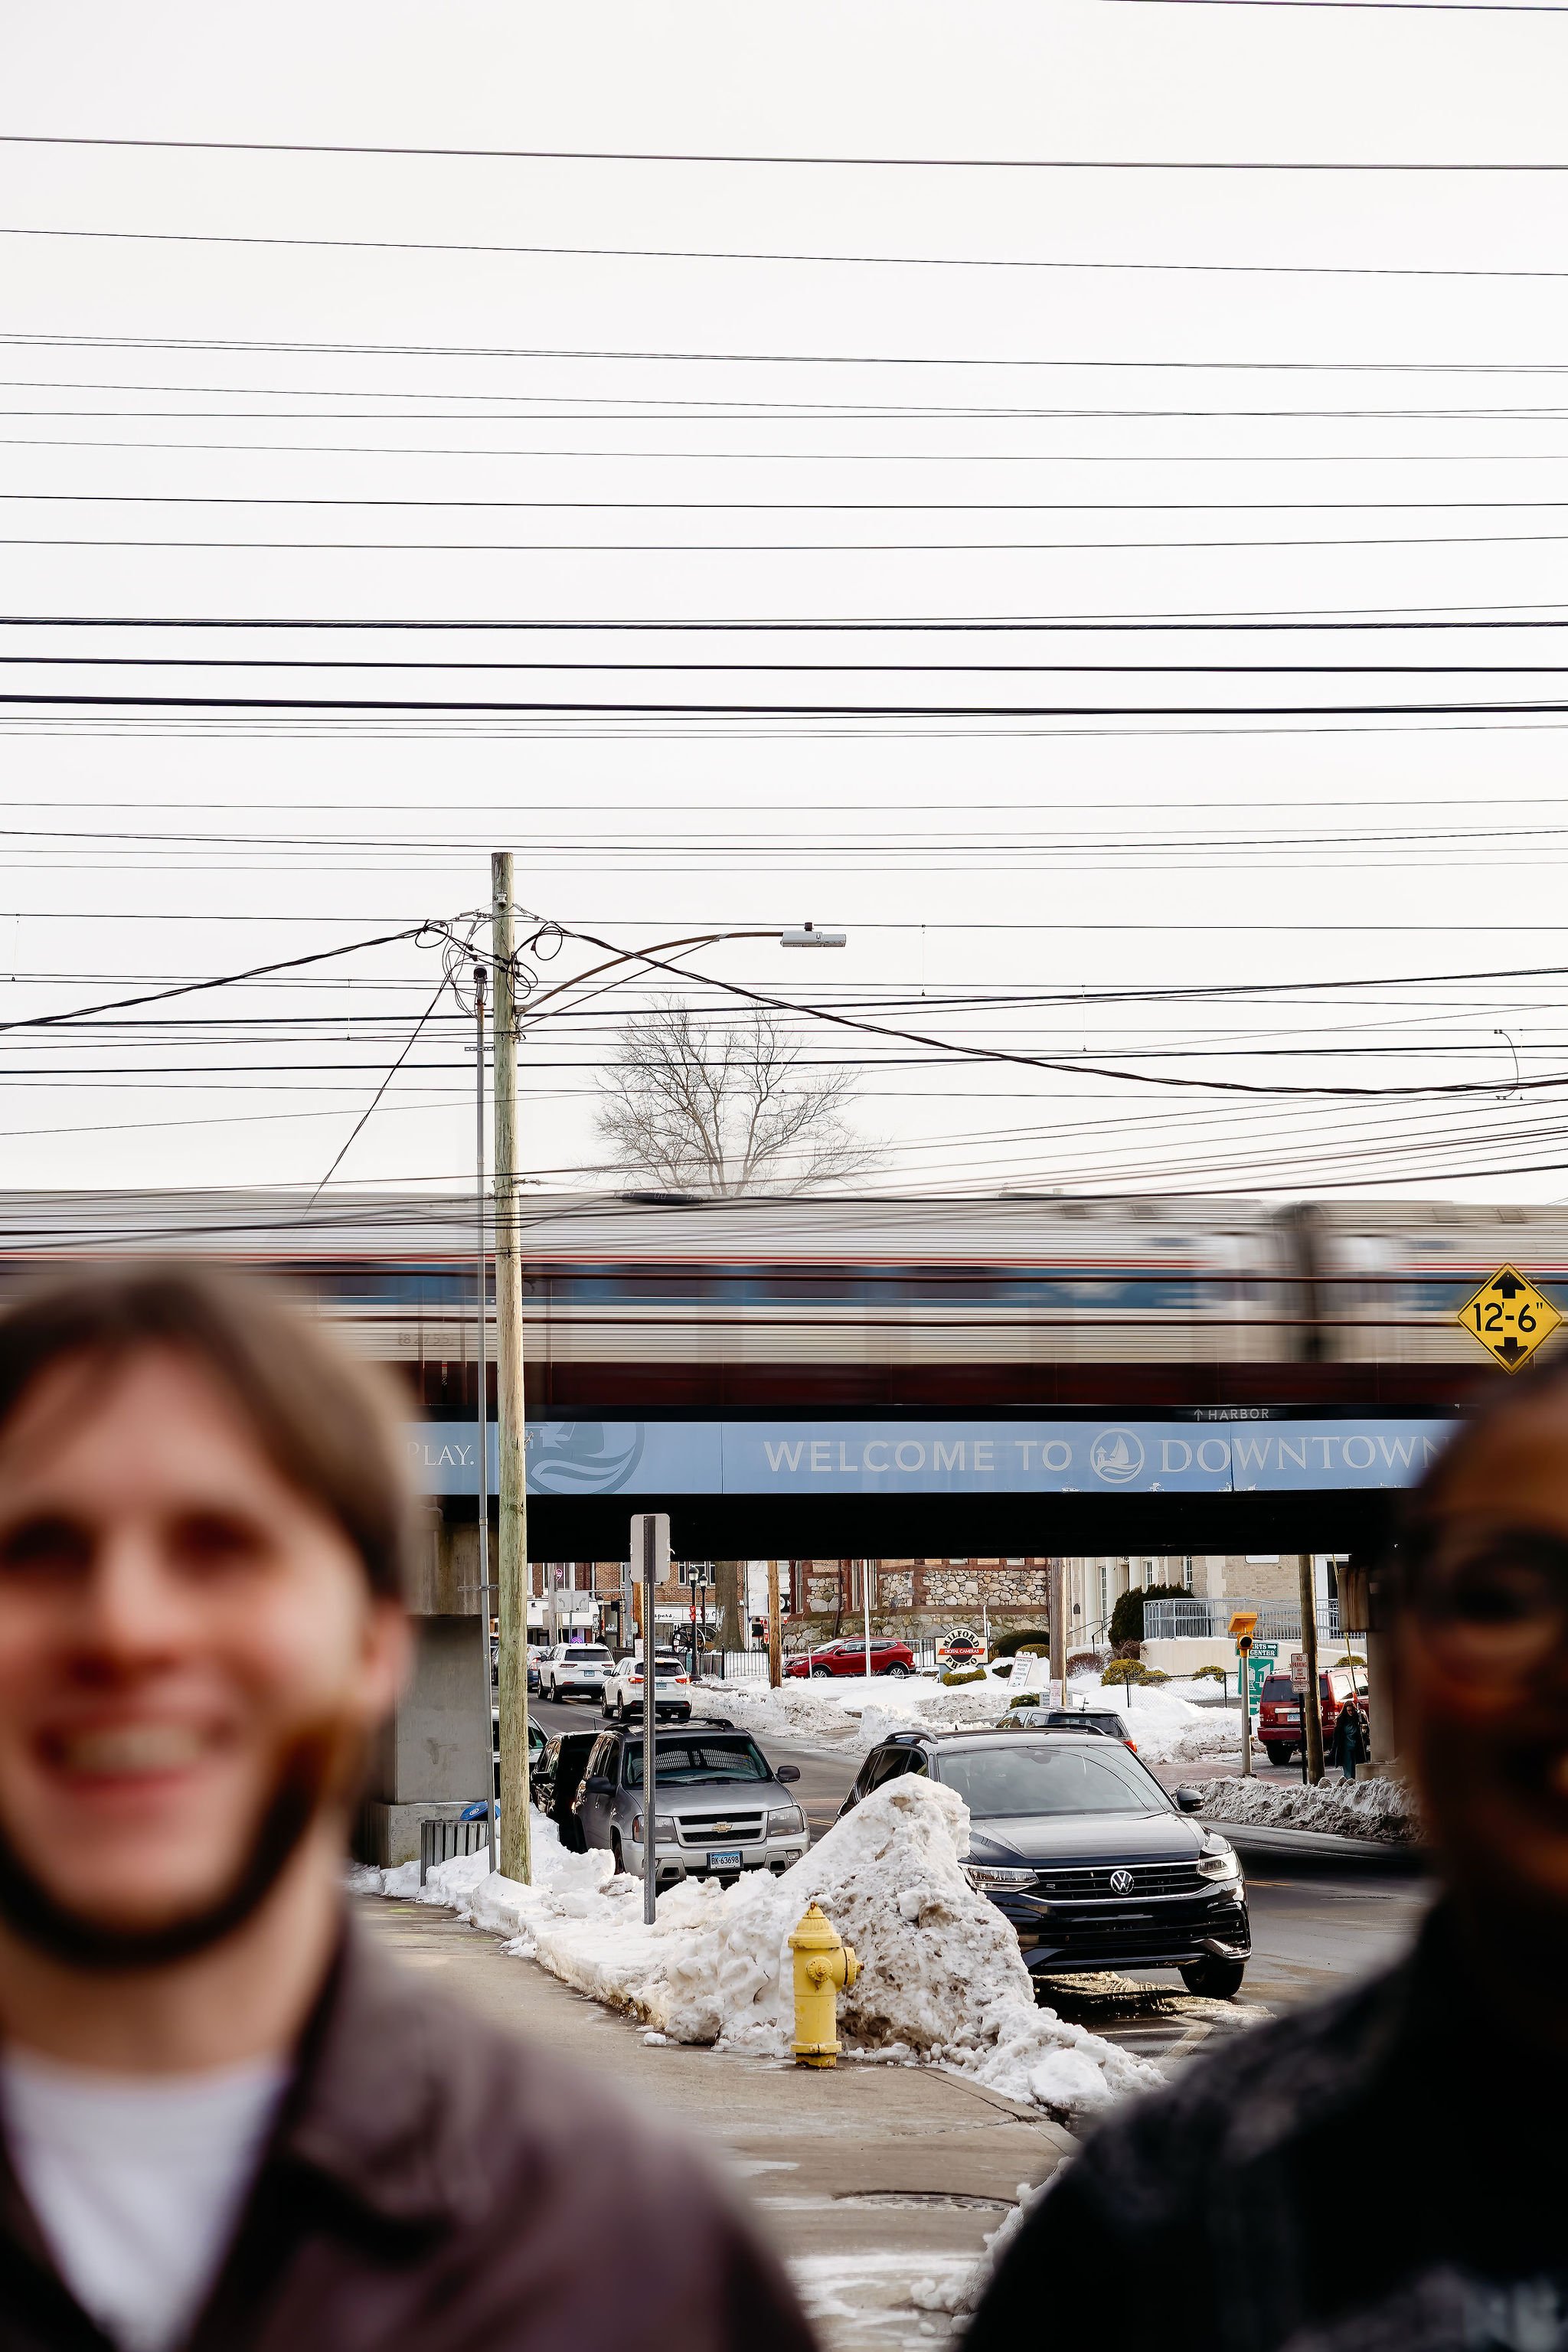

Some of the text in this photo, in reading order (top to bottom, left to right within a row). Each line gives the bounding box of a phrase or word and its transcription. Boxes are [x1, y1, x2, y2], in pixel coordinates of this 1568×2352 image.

[1208, 1409, 1269, 1420] HARBOR
[763, 1440, 995, 1472] WELCOME
[1014, 1440, 1073, 1472] TO
[942, 1630, 980, 1648] MILFORD
